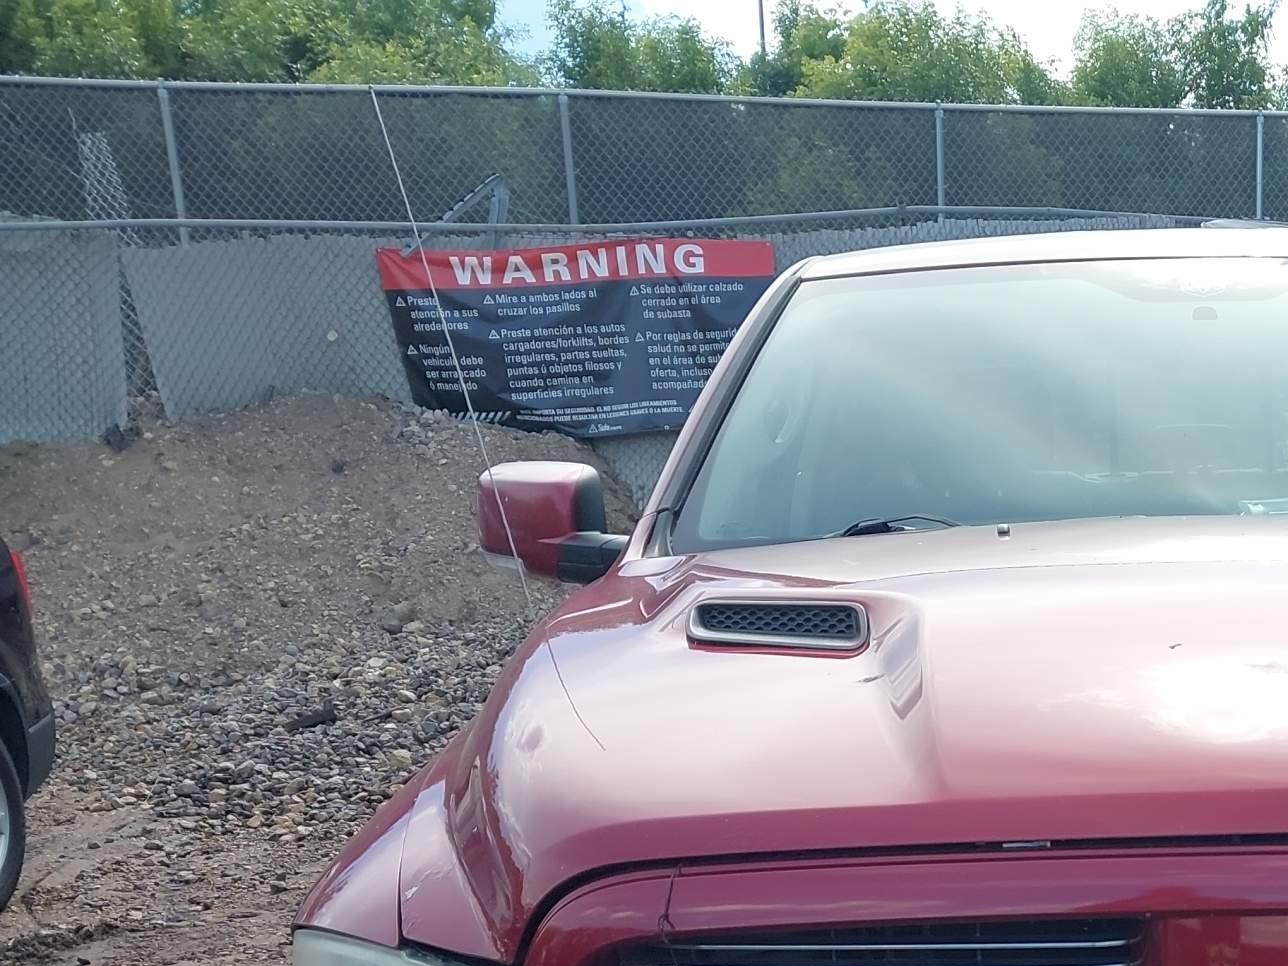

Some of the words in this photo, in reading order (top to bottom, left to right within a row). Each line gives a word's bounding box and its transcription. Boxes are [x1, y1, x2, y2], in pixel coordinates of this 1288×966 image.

[448, 244, 705, 285] WARNING
[640, 284, 652, 294] Se
[654, 284, 676, 294] debe
[678, 283, 706, 293] utilizar
[709, 282, 744, 292] calzado
[495, 294, 518, 304] Mire
[521, 295, 526, 303] a
[528, 292, 560, 302] ambos
[561, 289, 586, 300] lados
[588, 288, 597, 298] al
[641, 297, 677, 306] cerrado
[691, 295, 698, 305] el
[700, 295, 721, 304] área
[461, 309, 479, 317] sus
[498, 307, 528, 316] cruzar
[530, 305, 543, 315] los
[546, 302, 581, 314] pasillos
[643, 309, 654, 318] de
[656, 309, 691, 318] subasta
[501, 328, 531, 338] Preste
[534, 324, 574, 337] atención
[576, 326, 582, 334] a
[584, 324, 598, 333] los
[600, 323, 626, 333] autos
[646, 331, 661, 340] Por
[664, 331, 691, 342] reglas
[692, 329, 704, 340] de
[502, 337, 597, 352] cargadores/forklifts,
[598, 335, 629, 345] bordes
[647, 344, 671, 353] salud
[687, 344, 697, 352] se
[419, 344, 450, 356] Ningún
[504, 351, 559, 364] irregulares,
[560, 350, 590, 361] partes
[592, 348, 627, 358] sueltas,
[460, 354, 483, 366] debe
[648, 357, 660, 365] en
[662, 355, 670, 364] el
[673, 355, 693, 364] área
[695, 355, 706, 364] de
[426, 370, 440, 378] ser
[506, 366, 539, 378] puntas
[549, 363, 583, 375] objetos
[585, 361, 615, 371] filosos
[616, 361, 622, 371] y
[650, 367, 679, 378] oferta,
[681, 367, 713, 377] incluso
[437, 381, 478, 392] manejdo
[509, 378, 544, 388] cuando
[546, 376, 580, 386] camine
[582, 376, 594, 384] en
[652, 379, 707, 391] acompañad
[511, 389, 562, 401] superficies
[564, 386, 614, 398] irregulares
